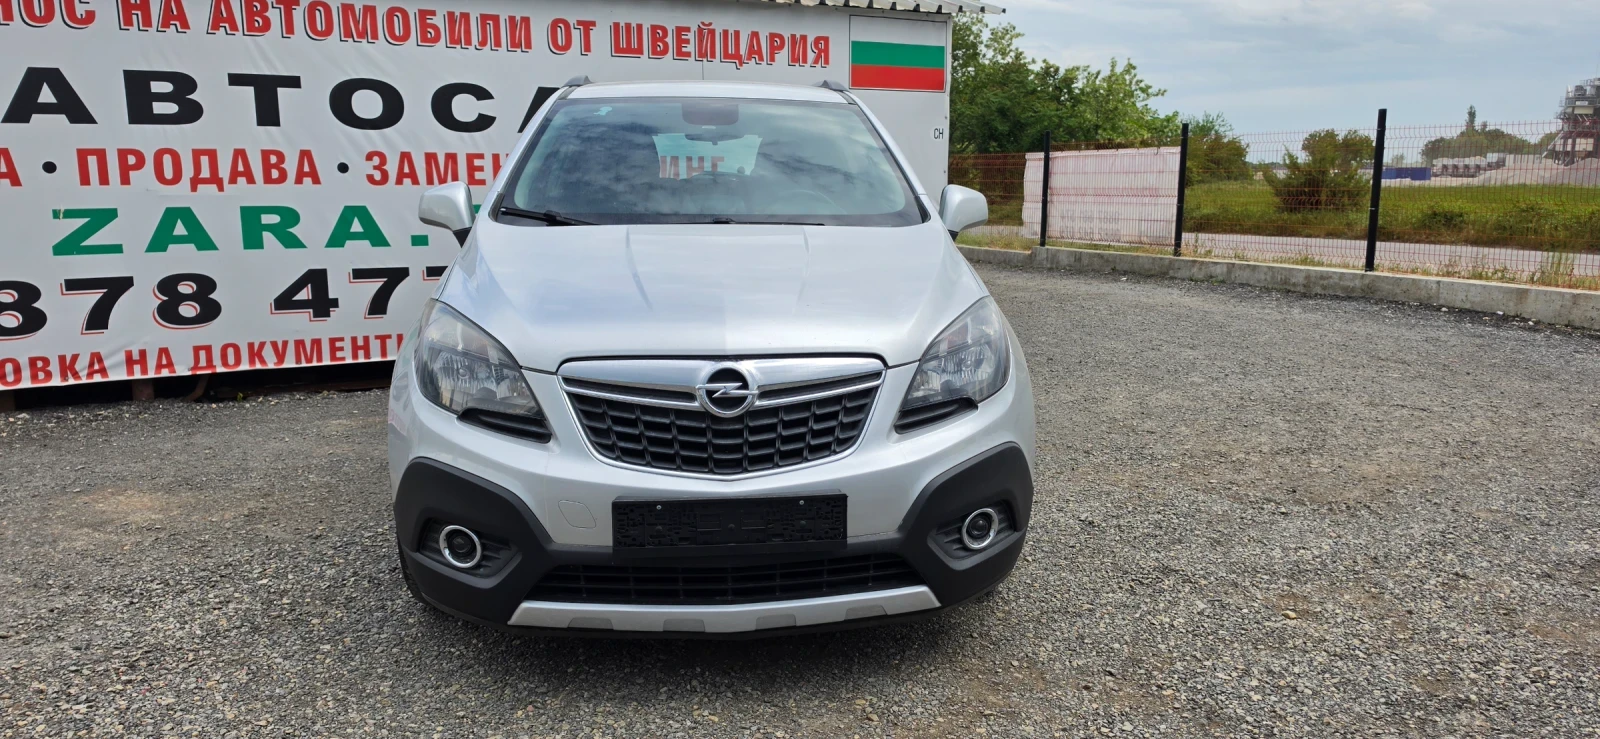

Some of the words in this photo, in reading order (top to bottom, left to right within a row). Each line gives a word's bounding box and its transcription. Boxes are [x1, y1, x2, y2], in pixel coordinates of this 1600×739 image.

[118, 0, 191, 35] НА
[206, 0, 533, 53] АВТОМОБИЛИ
[547, 17, 597, 56] ОТ
[610, 21, 830, 70] ШВЕЙЦАРИЯ
[75, 147, 322, 193] ПРОДАВА
[51, 204, 482, 256] ZARA.
[124, 346, 177, 378] НА
